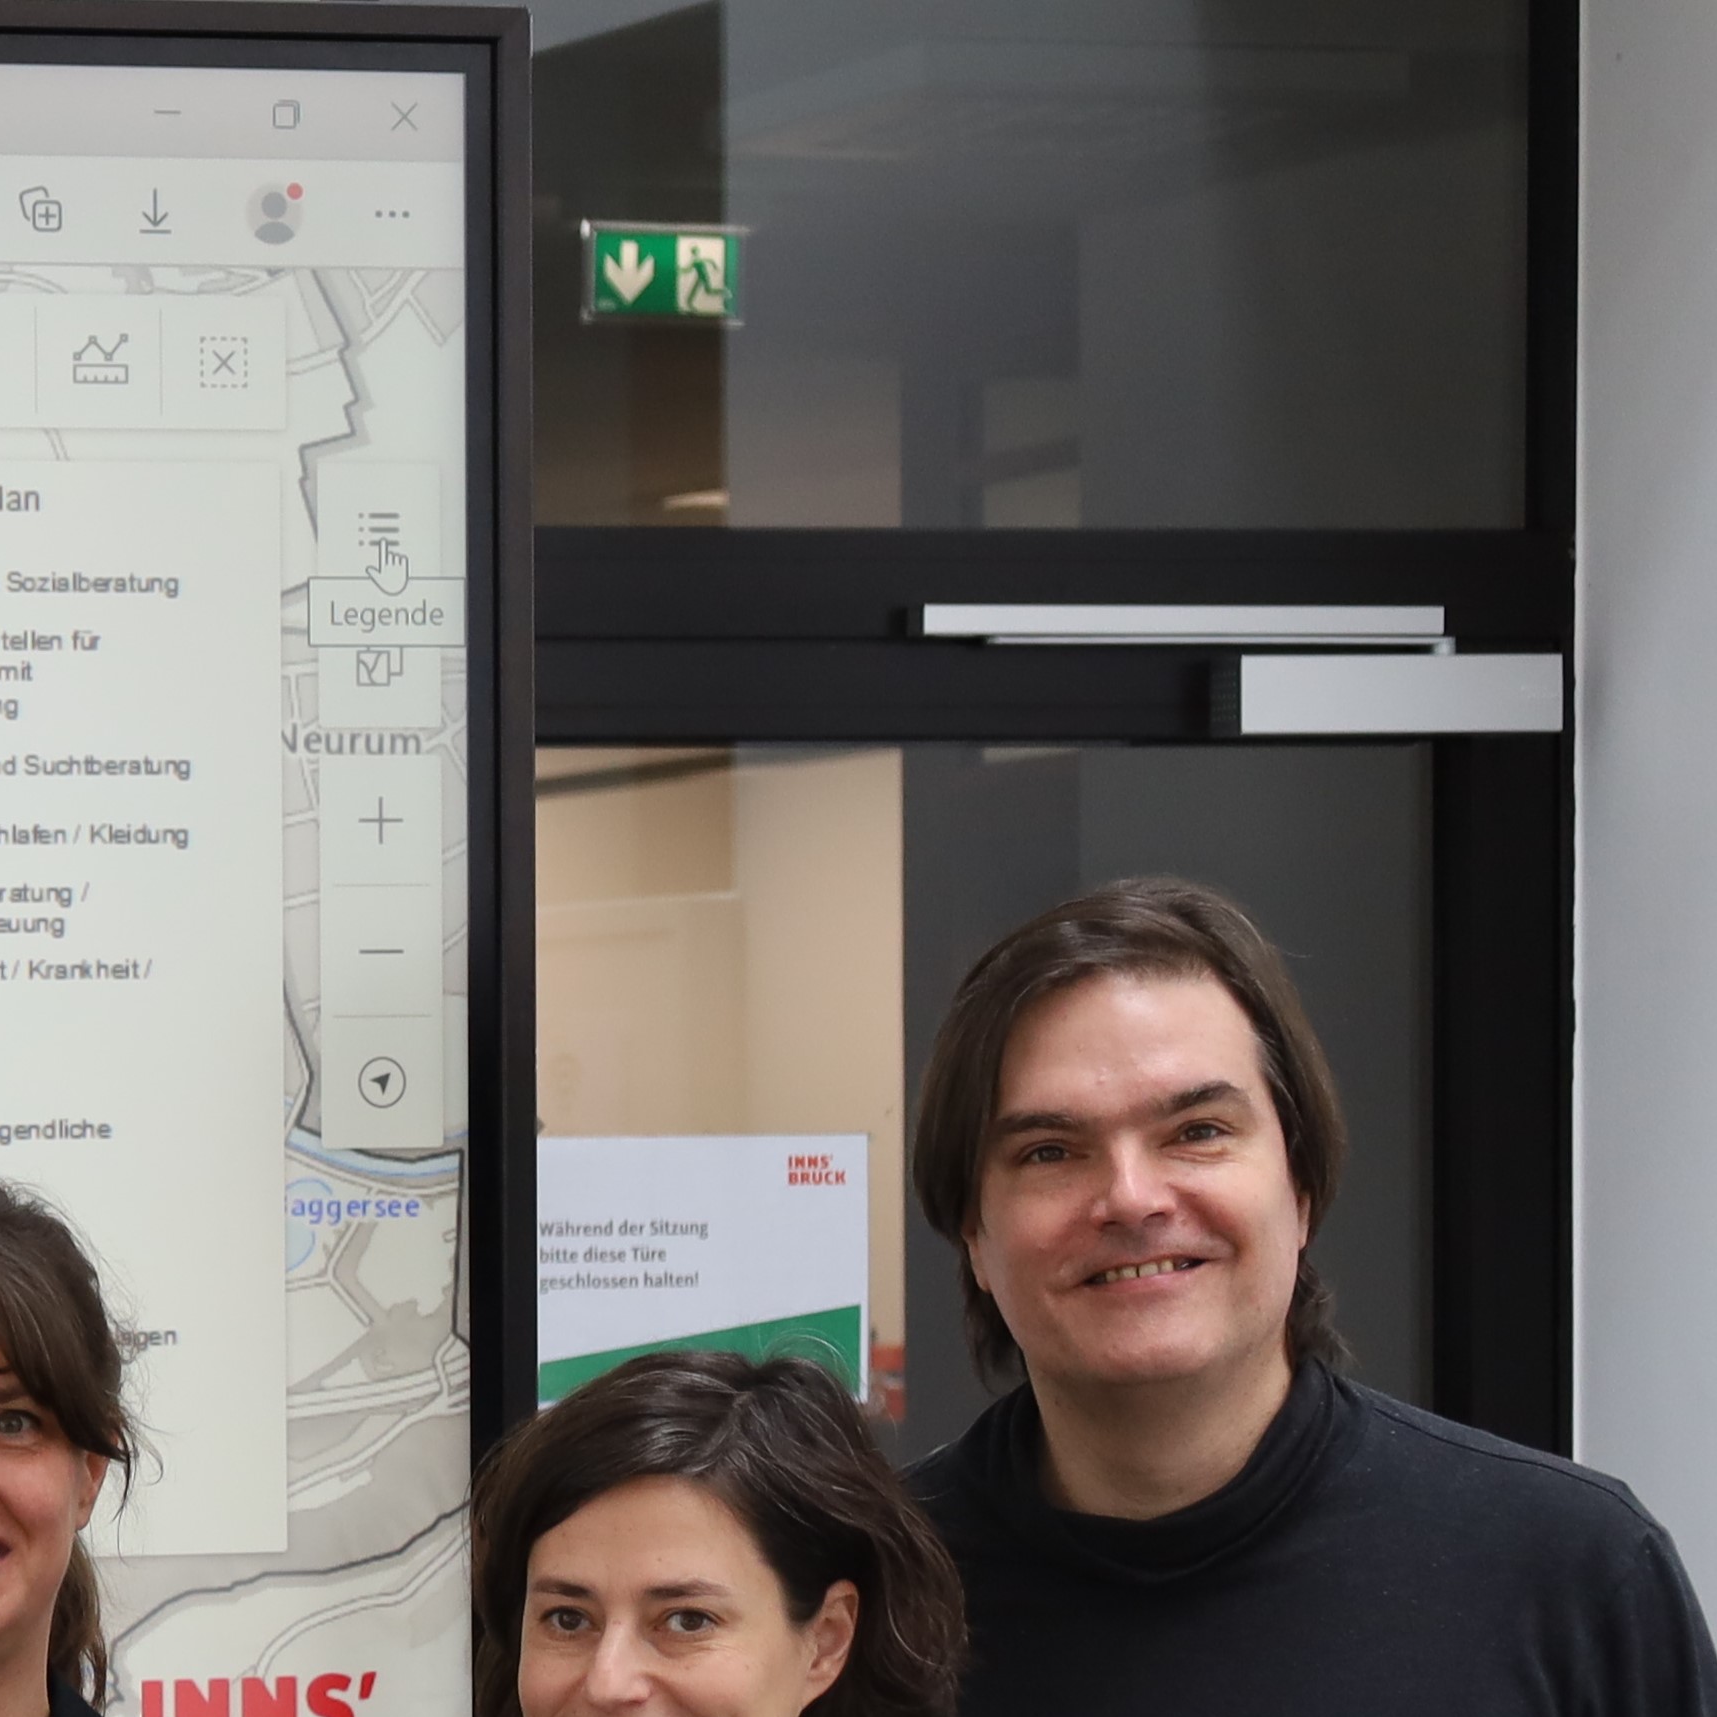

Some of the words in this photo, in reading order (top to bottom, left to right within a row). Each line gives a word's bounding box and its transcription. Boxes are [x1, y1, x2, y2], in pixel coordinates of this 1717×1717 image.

[6, 572, 180, 598] Sozialberatung
[329, 600, 445, 631] Legende
[71, 629, 101, 652] für
[24, 757, 191, 781] Suchtberatung
[89, 824, 190, 849] Kleidung
[27, 960, 141, 981] Krankheit
[788, 1170, 846, 1185] BRUCK
[285, 1196, 421, 1226] aggersee
[538, 1220, 614, 1237] Während
[618, 1219, 645, 1237] der
[649, 1219, 710, 1240] Sitzung
[539, 1246, 579, 1264] bitte
[583, 1244, 627, 1263] diese
[630, 1245, 668, 1262] Türe
[539, 1271, 639, 1296] geschlossen
[643, 1269, 700, 1289] halten!
